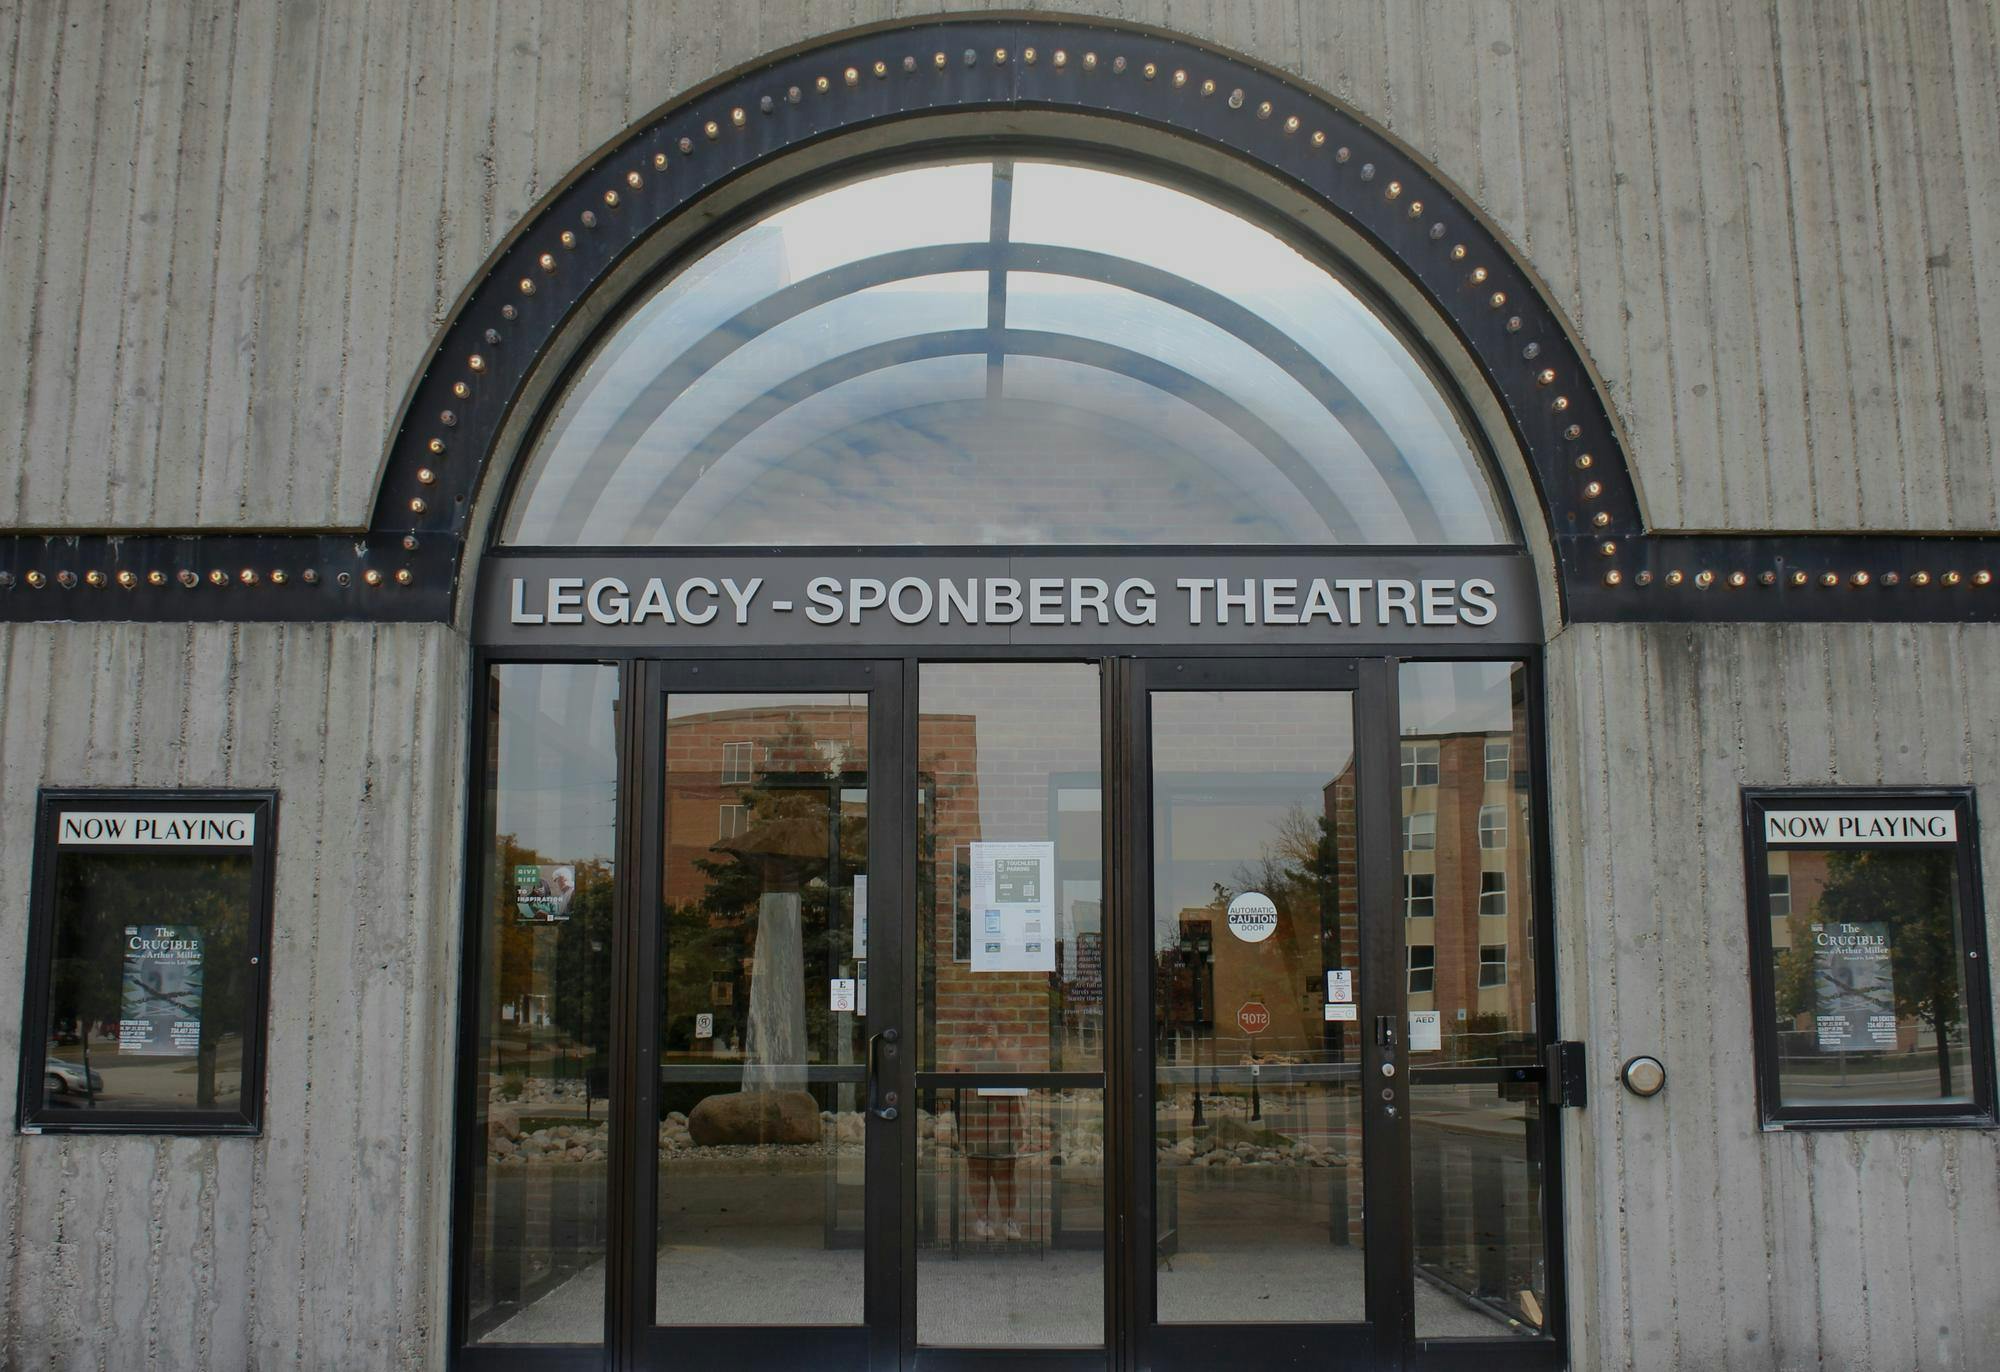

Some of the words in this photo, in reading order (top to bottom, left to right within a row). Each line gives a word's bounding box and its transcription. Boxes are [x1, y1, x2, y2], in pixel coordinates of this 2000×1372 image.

[510, 577, 762, 625] LEGACY
[804, 577, 1157, 625] SPONBERG
[1177, 578, 1498, 626] THEATRES
[65, 818, 127, 840] NOW
[135, 819, 246, 841] PLAYING
[1770, 816, 1829, 838] NOW
[1839, 816, 1946, 838] PLAYING
[1229, 915, 1276, 924] CAUTION
[155, 927, 175, 937] The
[1840, 923, 1860, 933] The
[129, 936, 199, 950] CRUCIBLE
[1817, 933, 1885, 946] CRUCIBLE
[147, 951, 174, 959] Arthur
[176, 951, 201, 959] Miller
[1864, 946, 1889, 954] Miller
[1336, 972, 1343, 980] E
